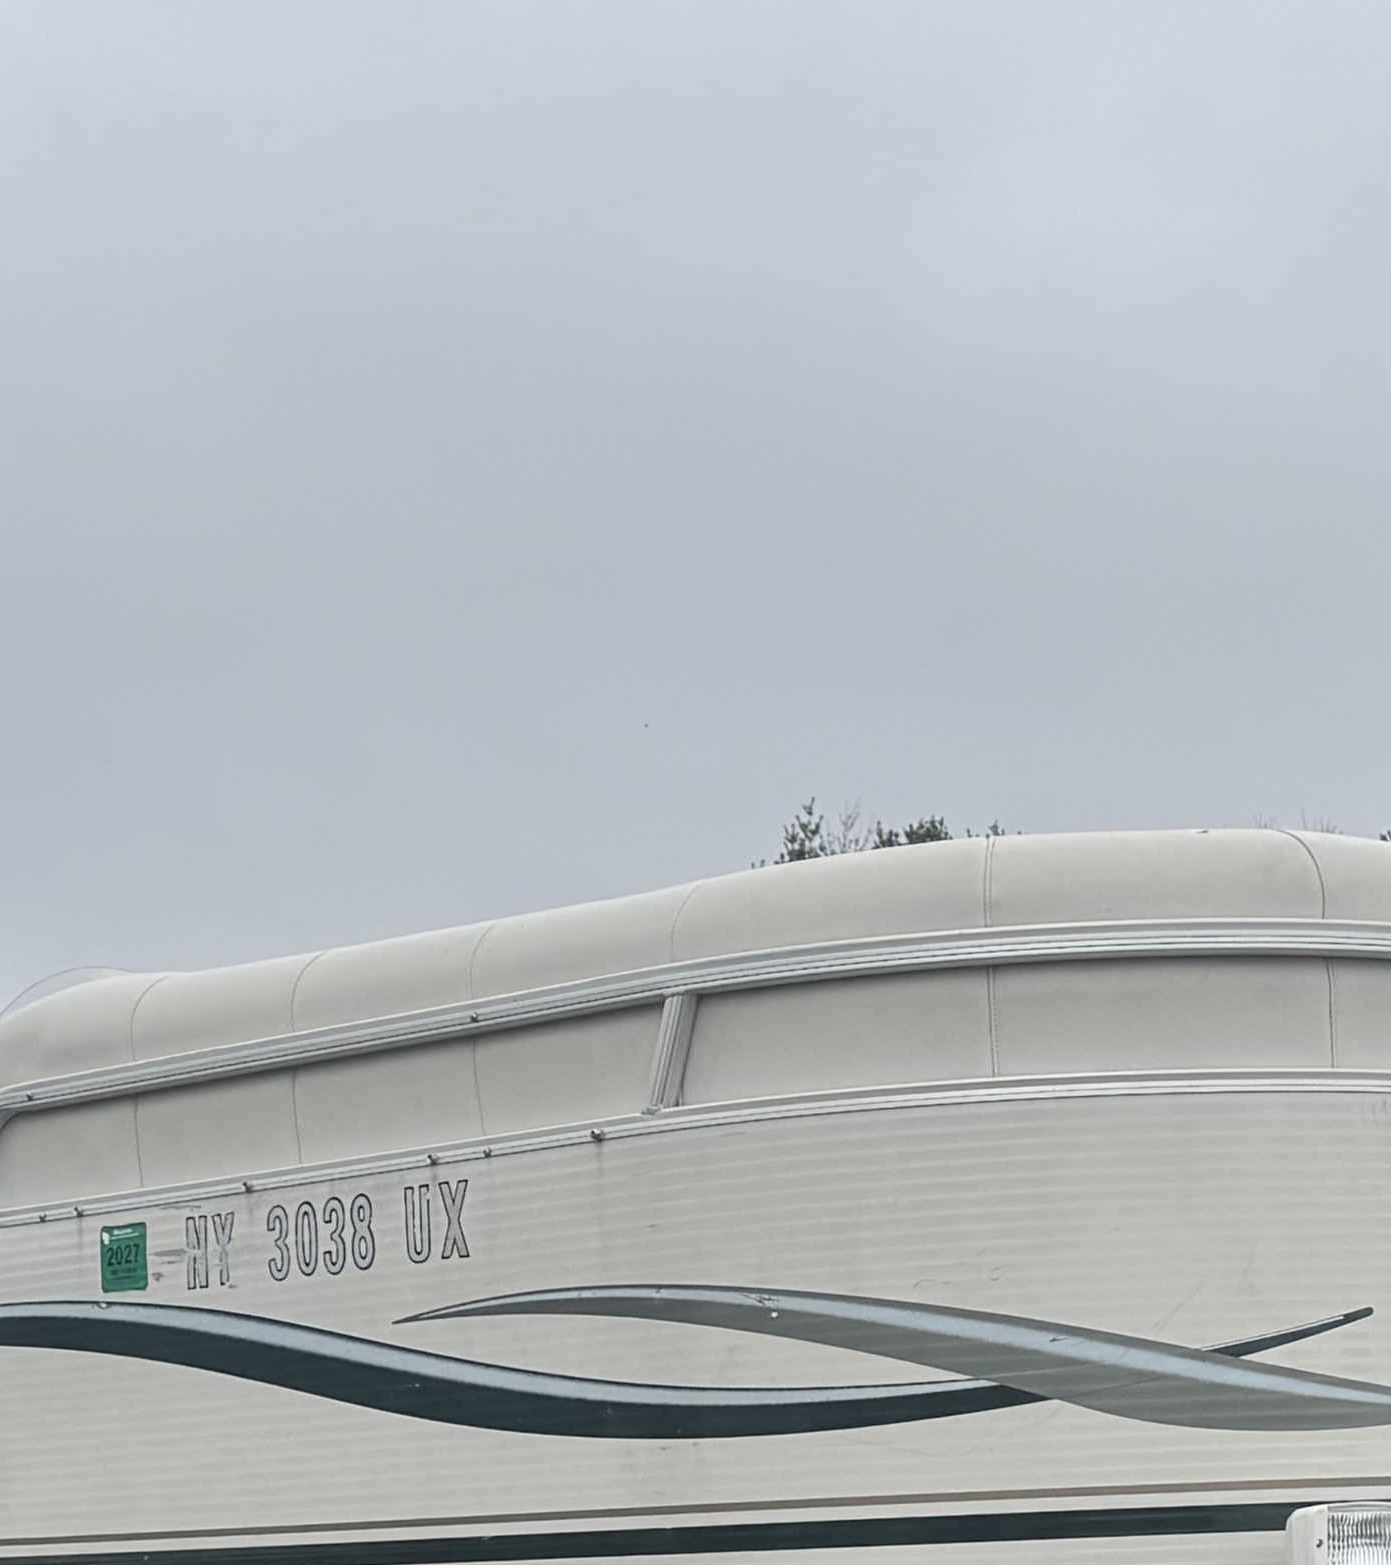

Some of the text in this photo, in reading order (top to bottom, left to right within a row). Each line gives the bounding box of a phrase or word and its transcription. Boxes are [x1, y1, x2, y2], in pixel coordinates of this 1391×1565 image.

[106, 1243, 139, 1266] 2027
[266, 1193, 375, 1281] 3038
[403, 1179, 469, 1263] UX
